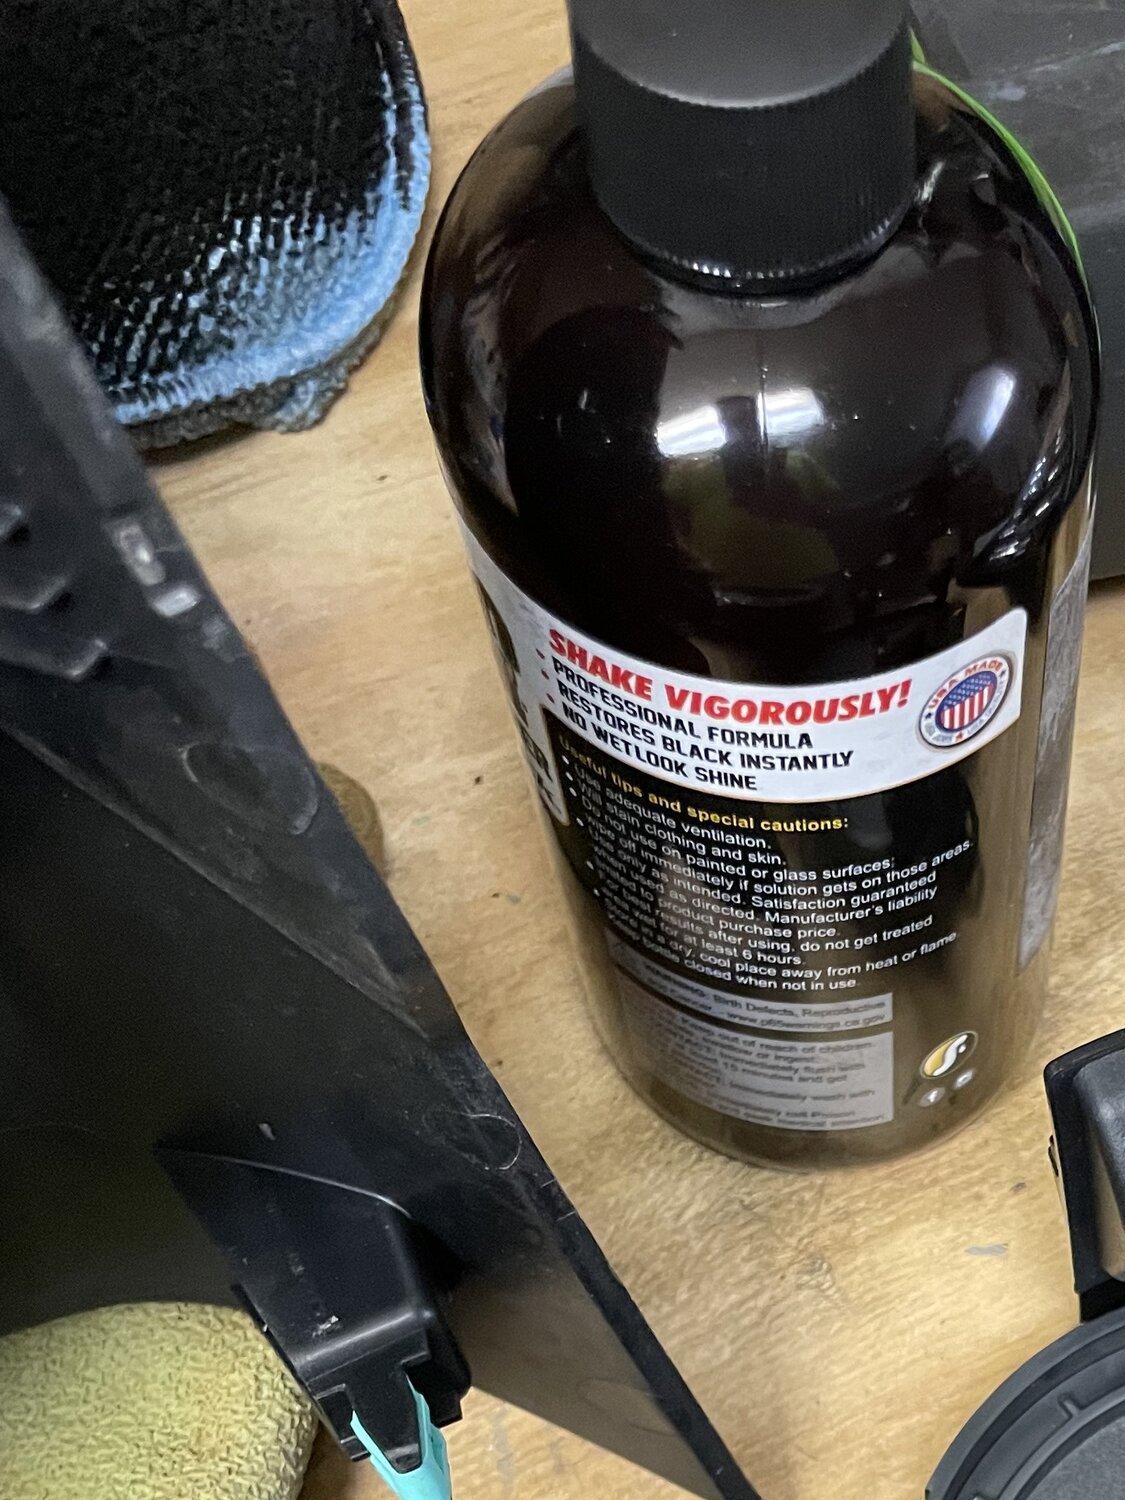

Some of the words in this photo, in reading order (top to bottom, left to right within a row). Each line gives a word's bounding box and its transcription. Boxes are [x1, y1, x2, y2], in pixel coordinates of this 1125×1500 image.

[549, 629, 653, 701] SHAKE
[664, 678, 912, 726] VIGOROUSLY!
[964, 659, 1004, 676] MADE
[552, 656, 701, 740] PROFESSIONAL
[707, 726, 814, 750] FORMULA
[557, 678, 656, 746] RESTORES
[661, 734, 732, 766] BLACK
[740, 750, 854, 771] INSTANTLY
[562, 701, 588, 732] NO
[695, 766, 758, 791] SHINE
[560, 735, 606, 780] Useful
[611, 771, 643, 798] tips
[648, 793, 682, 814] and
[687, 806, 754, 830] special
[760, 817, 849, 833] cautions:
[605, 787, 677, 829] adequate
[681, 822, 772, 850] ventilation.
[605, 814, 627, 835] not
[630, 830, 658, 850] use
[661, 845, 682, 860] on
[687, 853, 746, 878] painted
[751, 868, 768, 879] or
[773, 867, 817, 884] glass
[606, 802, 641, 828] stain
[645, 824, 706, 856] clothing
[711, 846, 743, 862] and
[749, 851, 787, 866] skin.
[618, 850, 646, 873] only
[651, 867, 670, 883] as
[674, 878, 747, 905] intended.
[752, 896, 846, 911] Satisfaction
[850, 870, 937, 908] guaranteed
[619, 837, 637, 853] off
[641, 849, 734, 890] immediately
[739, 879, 749, 891] if
[754, 881, 818, 896] solution
[822, 881, 857, 897] gets
[861, 876, 881, 889] on
[886, 861, 928, 883] those
[630, 870, 665, 894] used
[669, 889, 688, 904] as
[692, 897, 761, 921] directed.
[765, 903, 884, 925] Manufacturer's
[888, 885, 937, 911] liability
[640, 886, 654, 902] to
[658, 898, 714, 926] product
[719, 919, 792, 939] purchase
[655, 909, 703, 935] results
[708, 929, 743, 945] after
[800, 942, 820, 952] do
[825, 938, 849, 951] not
[854, 932, 878, 949] get
[883, 914, 933, 941] treated
[660, 922, 678, 937] for
[684, 934, 697, 947] at
[701, 939, 739, 957] least
[742, 949, 753, 960] 6
[684, 959, 732, 981] closed
[736, 974, 778, 990] when
[782, 980, 807, 991] not
[810, 979, 825, 990] in
[700, 952, 731, 968] cool
[735, 963, 777, 977] place
[781, 968, 822, 981] away
[827, 963, 861, 977] from
[865, 955, 898, 972] heat
[901, 949, 917, 962] or
